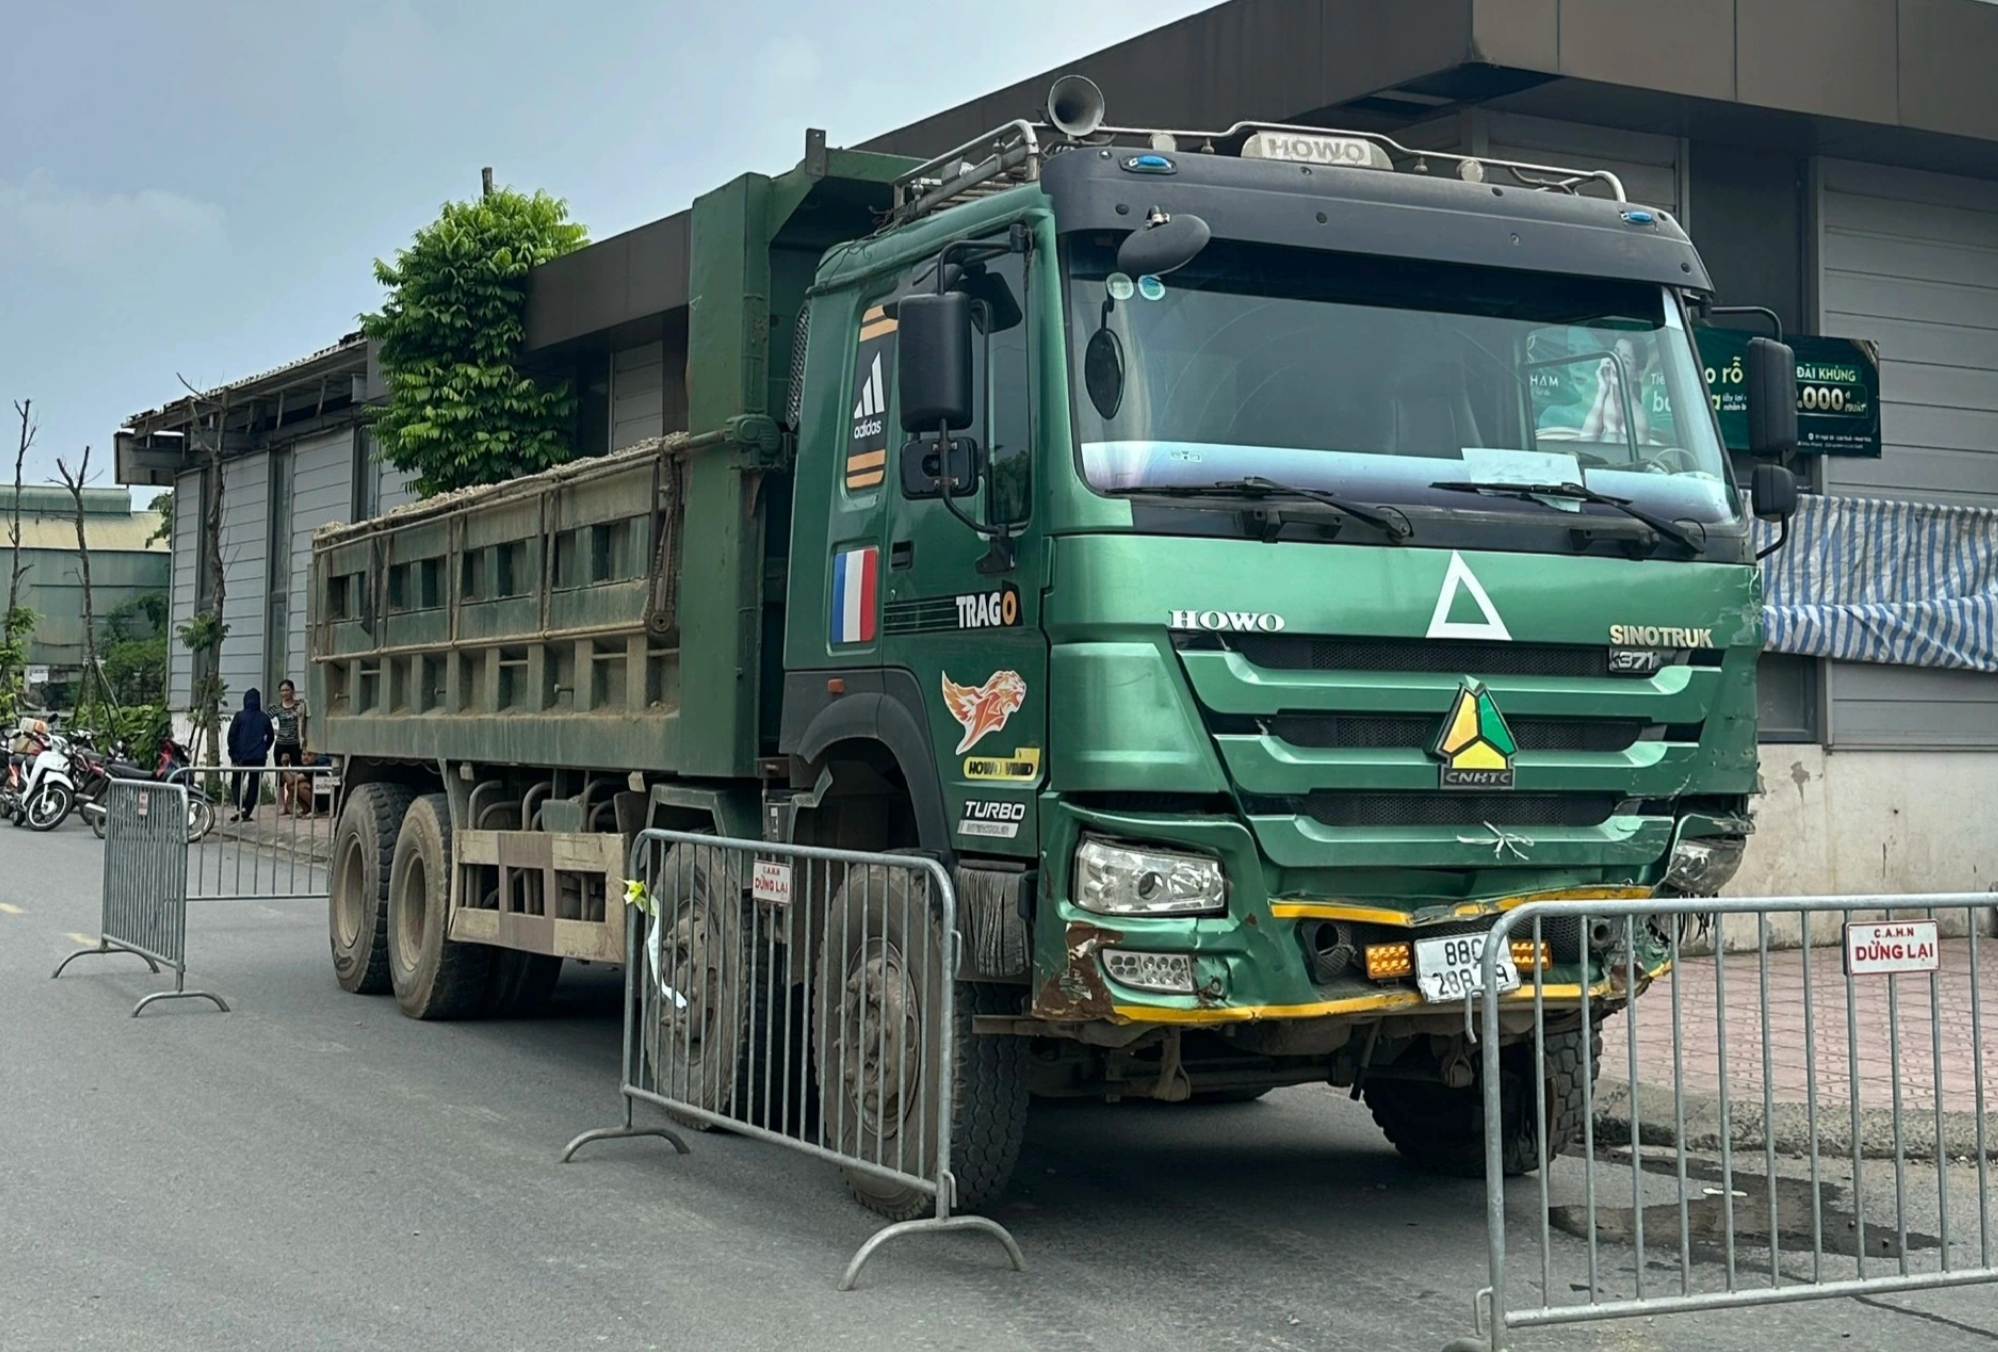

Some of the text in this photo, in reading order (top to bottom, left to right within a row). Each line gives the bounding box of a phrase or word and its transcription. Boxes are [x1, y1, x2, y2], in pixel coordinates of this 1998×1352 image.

[1269, 137, 1365, 163] HOWO
[1819, 366, 1856, 382] KHỦNG
[854, 419, 882, 439] adidas
[956, 590, 1017, 629] TRAGO
[1168, 609, 1285, 632] HOWO
[1609, 624, 1714, 648] SINOTRUK
[1445, 771, 1512, 784] CNHTC
[965, 800, 1026, 820] TURBO
[1444, 937, 1484, 966] 88C
[1855, 940, 1934, 962] DỪNG LẠI
